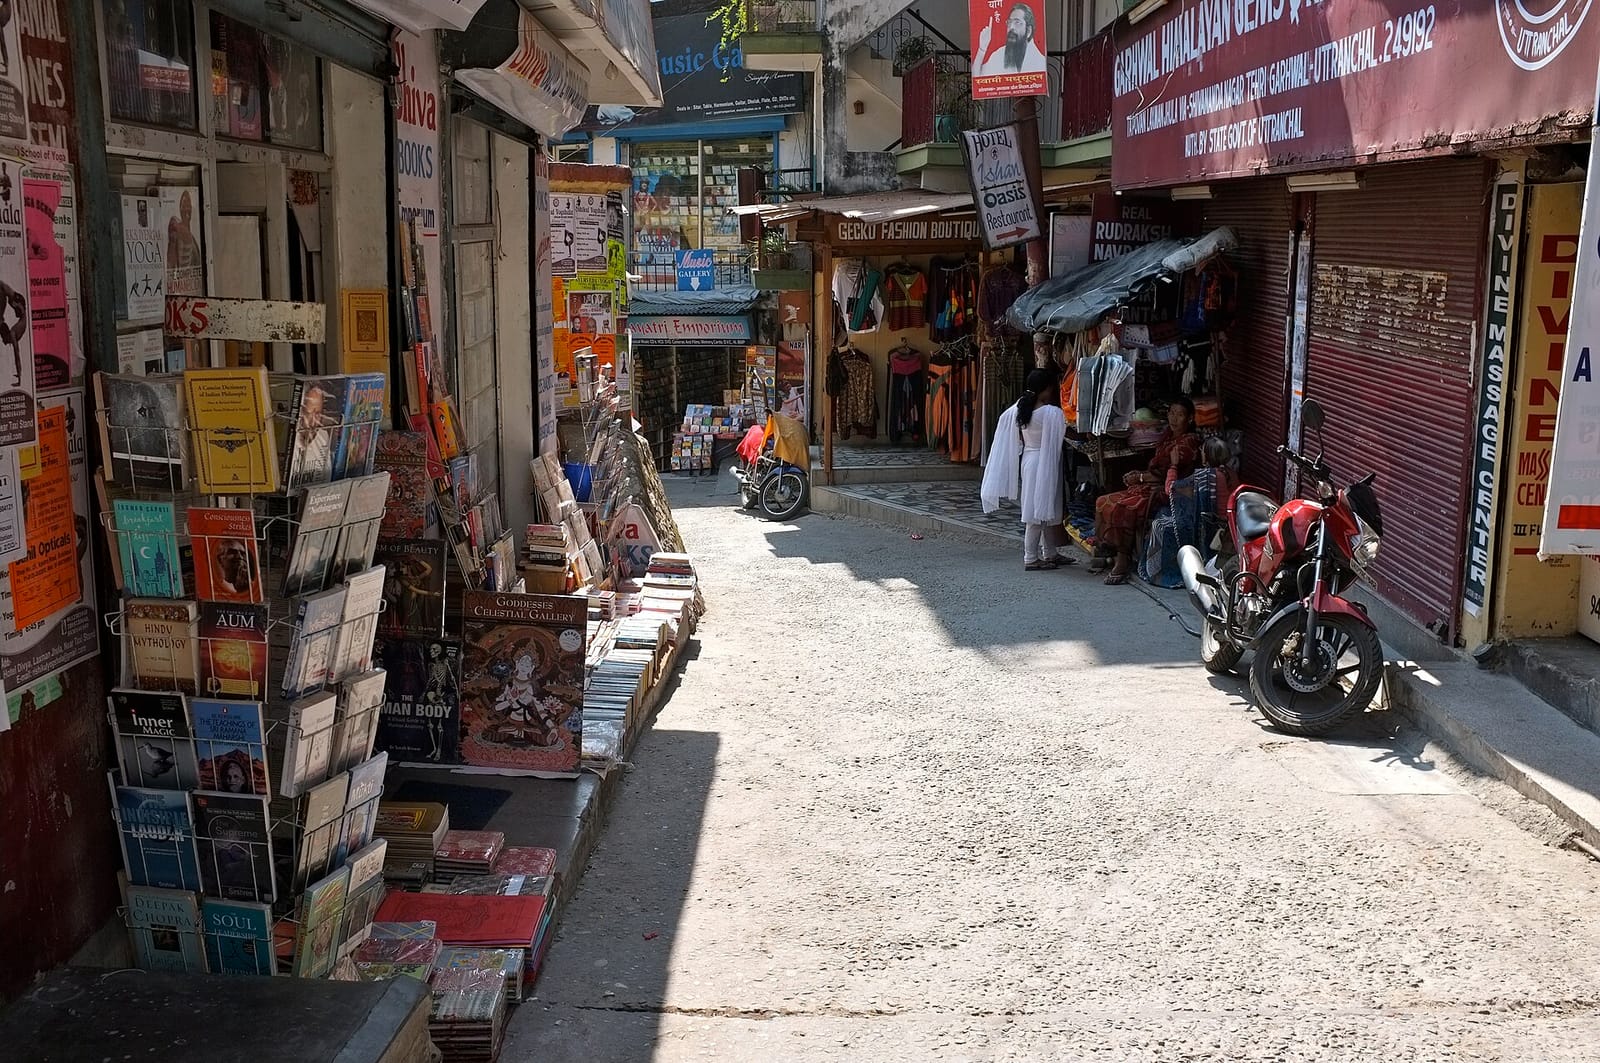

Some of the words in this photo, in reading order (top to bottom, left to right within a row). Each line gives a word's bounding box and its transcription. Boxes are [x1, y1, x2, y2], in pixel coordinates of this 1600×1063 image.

[1516, 12, 1573, 58] UTTRANCHAL
[1114, 31, 1160, 98] GARHWAL
[1208, 126, 1227, 152] STATE
[1257, 107, 1305, 145] UTTRANCHAL
[971, 128, 1013, 159] HOTEL
[983, 184, 1027, 209] Oasis
[985, 204, 1034, 231] Restaurant
[1121, 205, 1153, 220] REAL
[880, 221, 928, 240] FASHION
[931, 219, 984, 241] BOUTIQU
[1096, 221, 1173, 241] RUDRAKSH
[678, 250, 712, 268] Music
[678, 270, 712, 278] GALLERY
[673, 319, 745, 336] Emporium
[1469, 469, 1494, 589] CENTER
[496, 597, 554, 611] GODDESSES
[473, 605, 527, 621] CELESTIAL
[528, 608, 576, 623] GALLERY
[144, 622, 173, 635] HINDU
[215, 617, 255, 630] AUM
[133, 636, 186, 650] MYTHOLOGY
[381, 702, 412, 717] MAN
[415, 704, 452, 719] BODY
[143, 726, 176, 737] MAGIC
[133, 910, 192, 928] CHOPRA
[211, 916, 258, 931] SOUL
